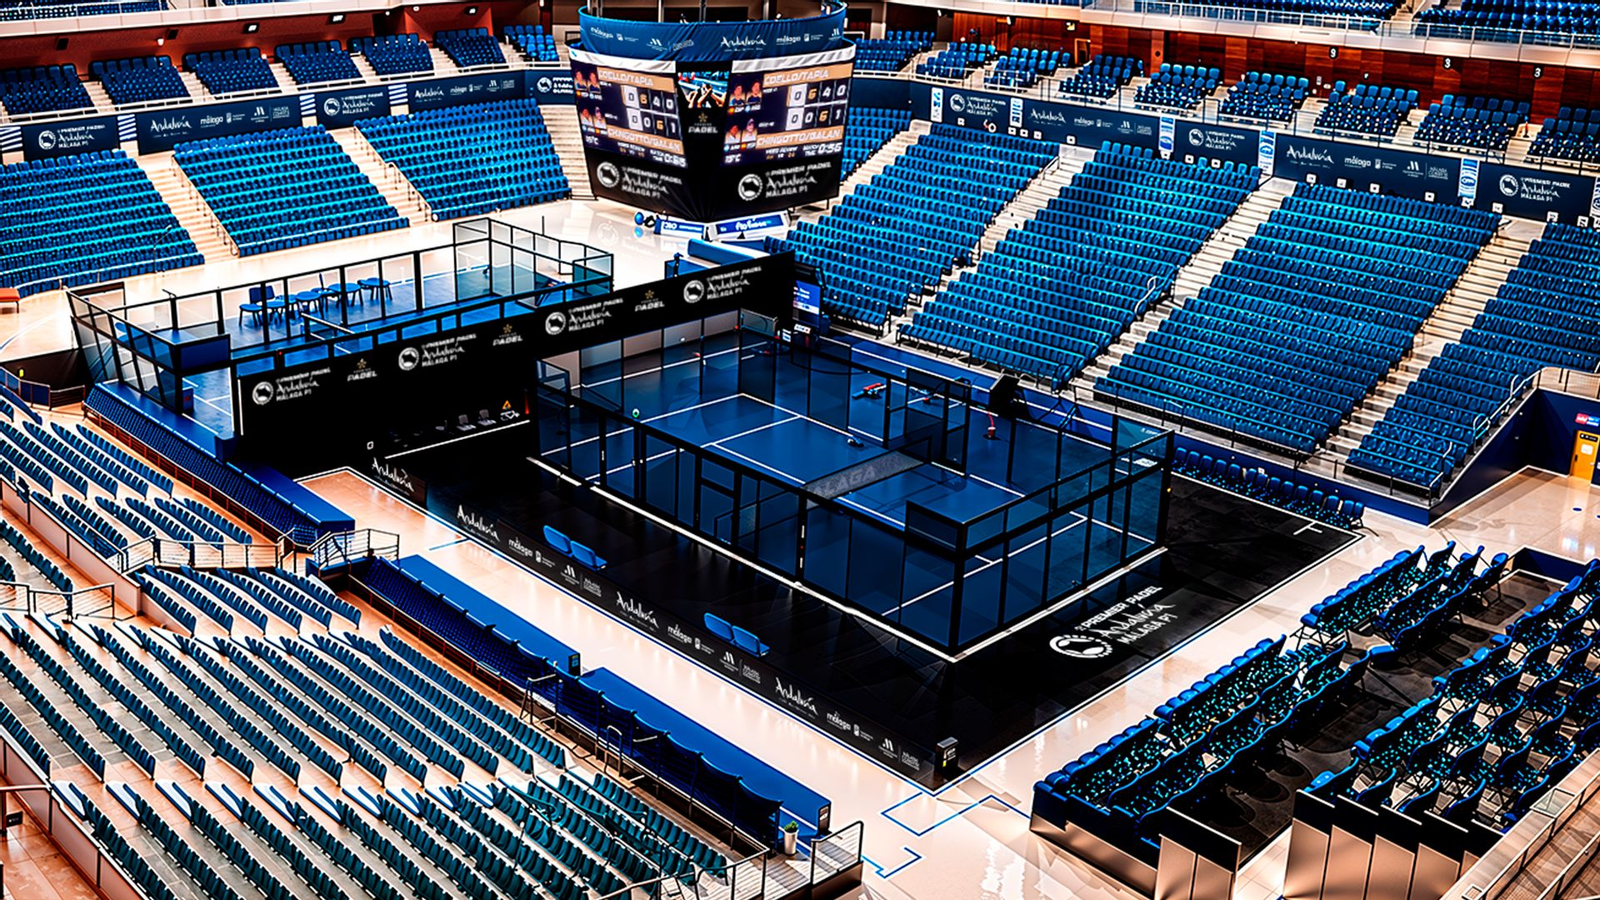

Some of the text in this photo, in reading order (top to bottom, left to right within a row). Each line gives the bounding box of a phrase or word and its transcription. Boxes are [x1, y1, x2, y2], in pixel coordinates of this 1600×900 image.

[1286, 144, 1334, 164] Andalucía
[616, 591, 660, 629] Andalucía
[1081, 586, 1163, 629] PREMIER PADEL
[775, 676, 818, 715] Andalucía
